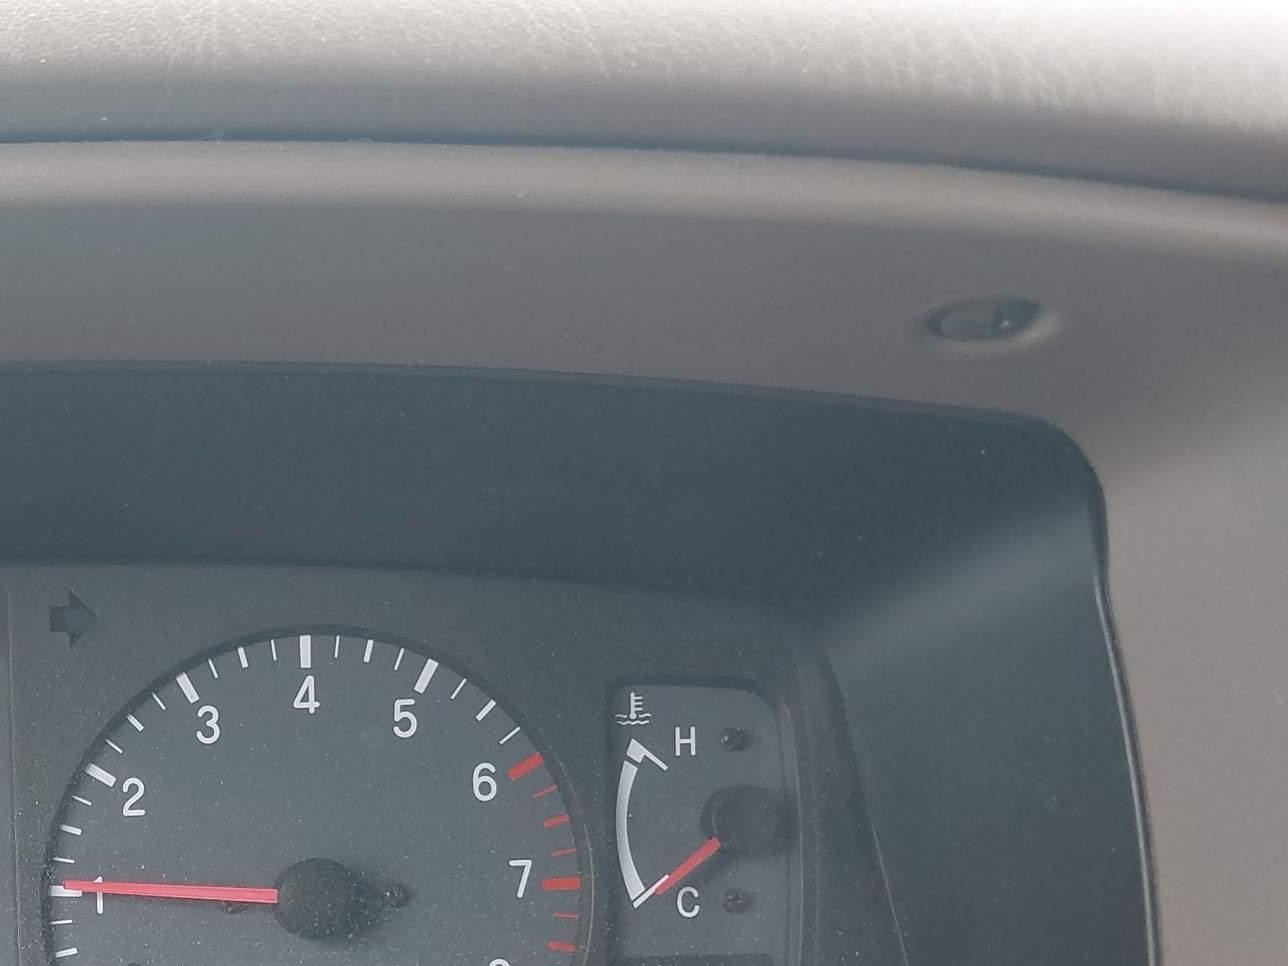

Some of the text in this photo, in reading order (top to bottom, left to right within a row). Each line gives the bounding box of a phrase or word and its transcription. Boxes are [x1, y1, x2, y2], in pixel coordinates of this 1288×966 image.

[293, 675, 320, 713] 4
[196, 705, 220, 744] 3
[394, 698, 417, 738] 5
[674, 726, 696, 756] H
[122, 778, 146, 816] 2
[472, 763, 497, 801] 6
[95, 876, 104, 914] 1
[508, 859, 532, 898] 7
[676, 886, 700, 918] C
